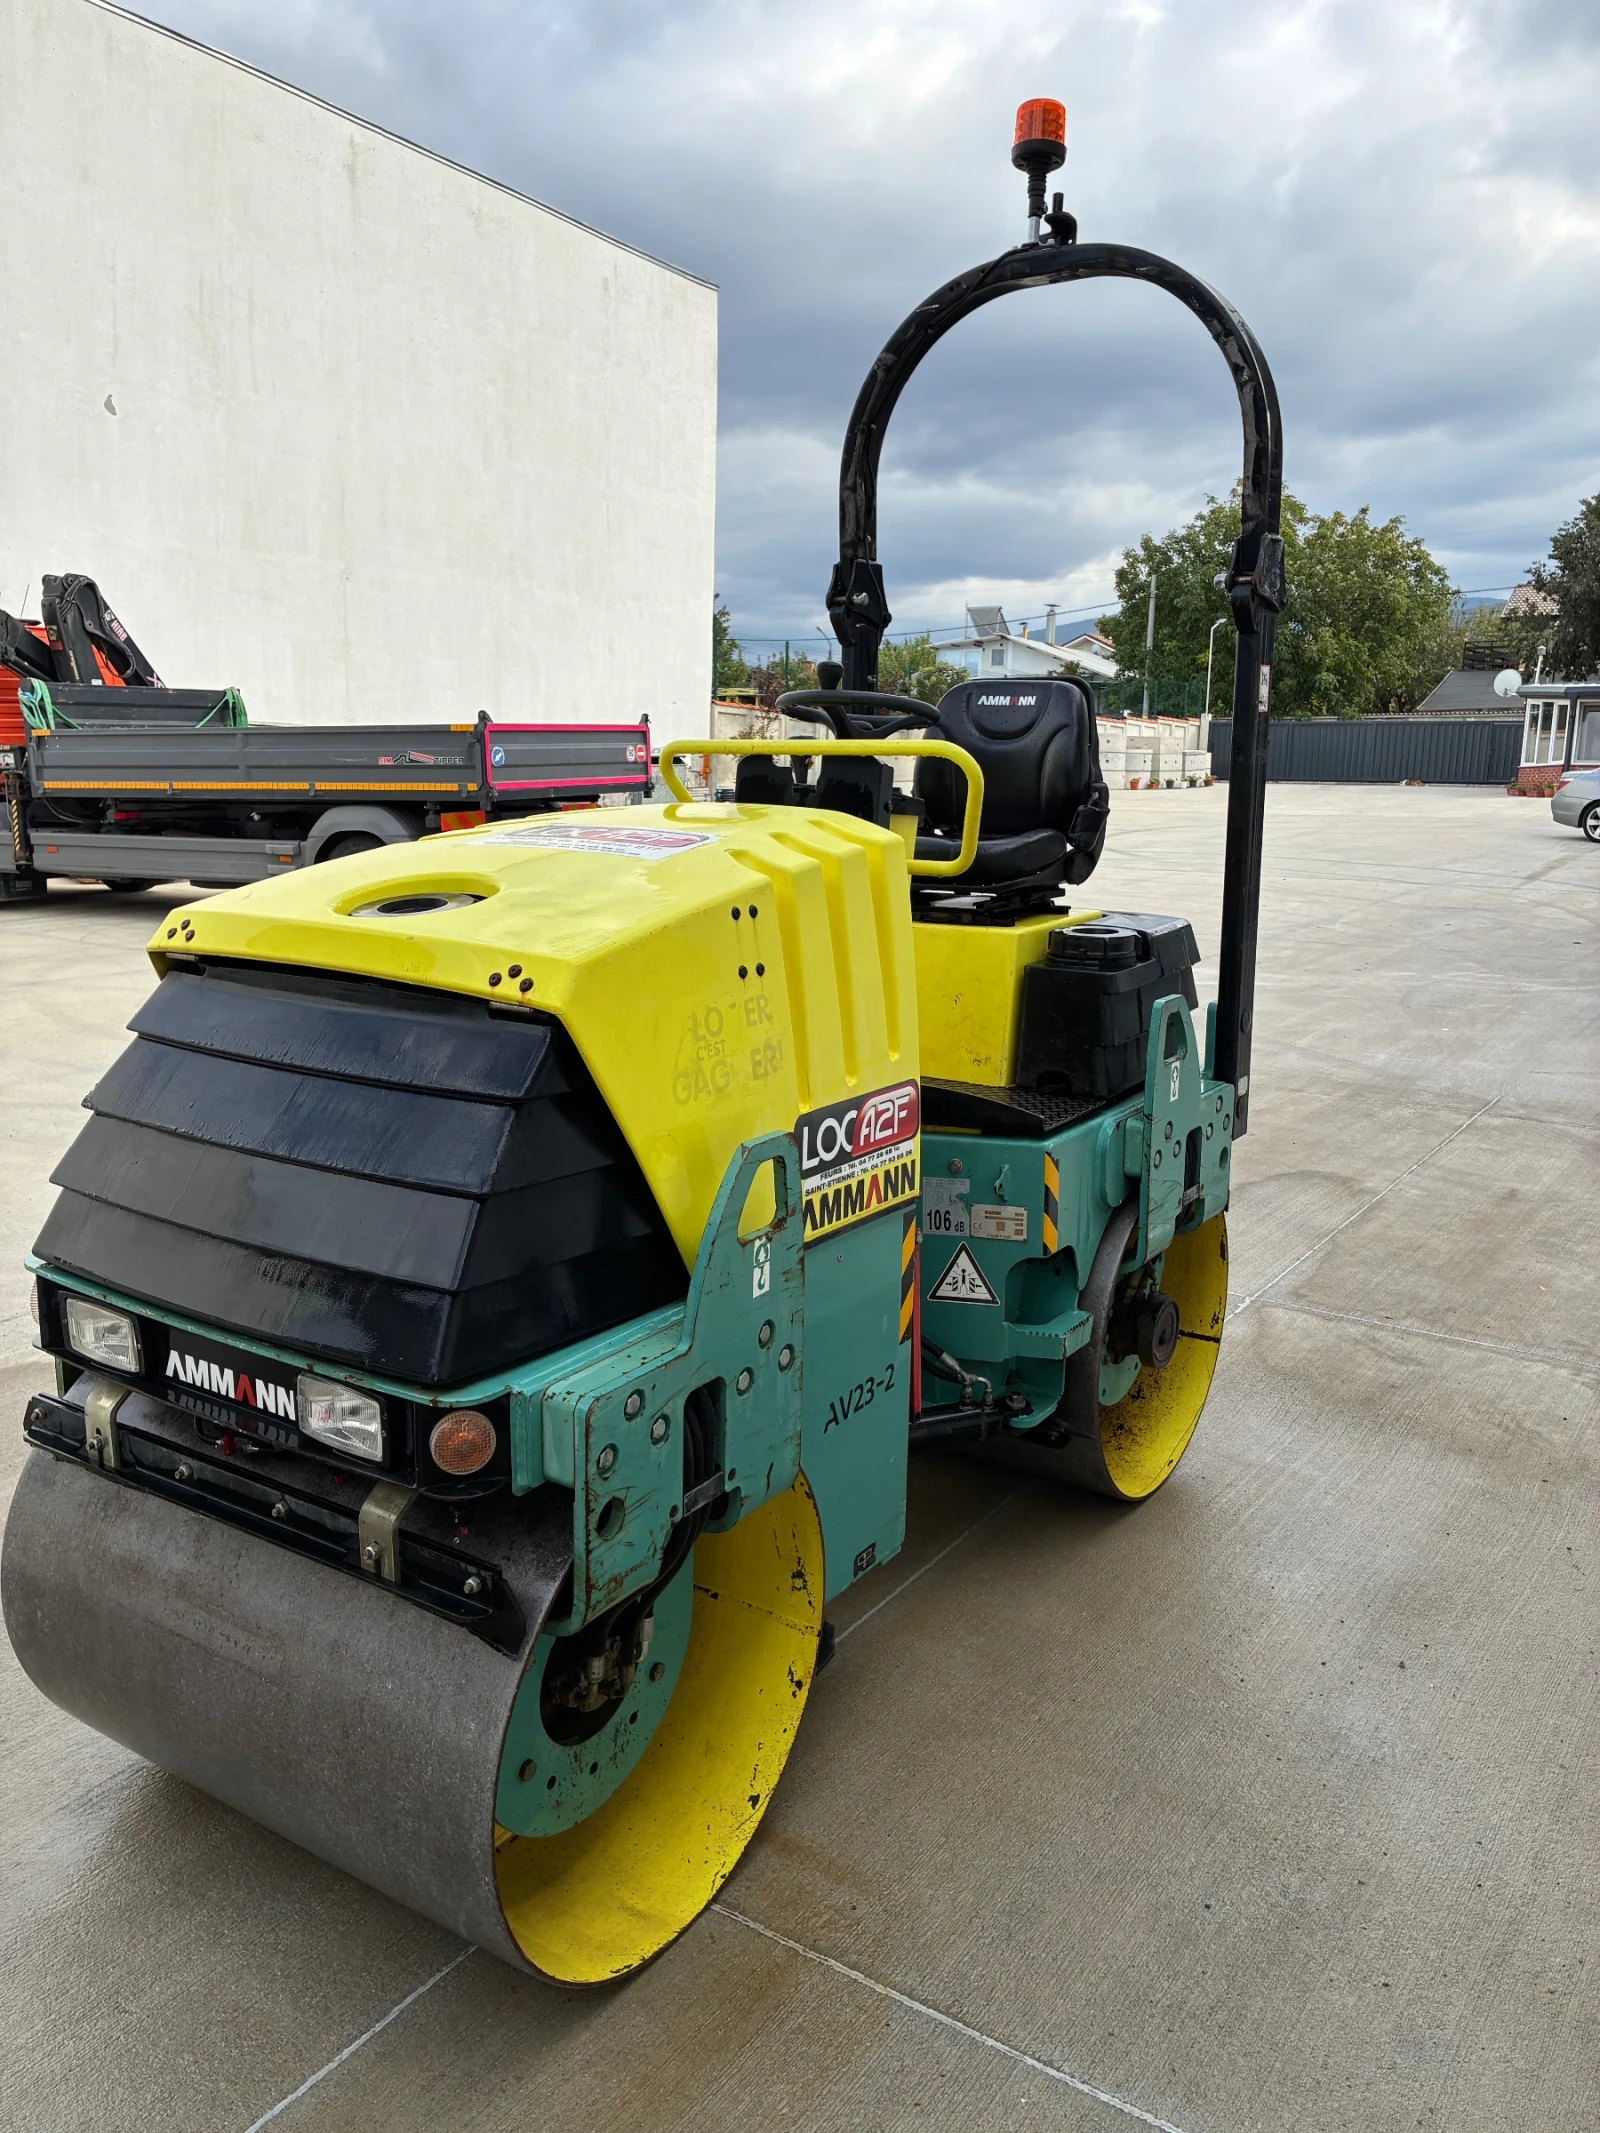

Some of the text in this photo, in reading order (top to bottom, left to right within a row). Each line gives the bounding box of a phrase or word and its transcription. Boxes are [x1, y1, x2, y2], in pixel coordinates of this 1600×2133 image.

[977, 695, 1037, 706] AMMANN
[434, 757, 464, 765] TIPPER
[820, 1167, 843, 1181] FEURS
[859, 1158, 867, 1166] 04
[802, 1159, 916, 1232] AMMANN
[804, 1171, 856, 1196] SAINT-ETIENNE
[927, 1209, 965, 1232] 106 dB
[165, 1350, 297, 1421] AMMANN
[823, 1363, 896, 1435] AV23-2
